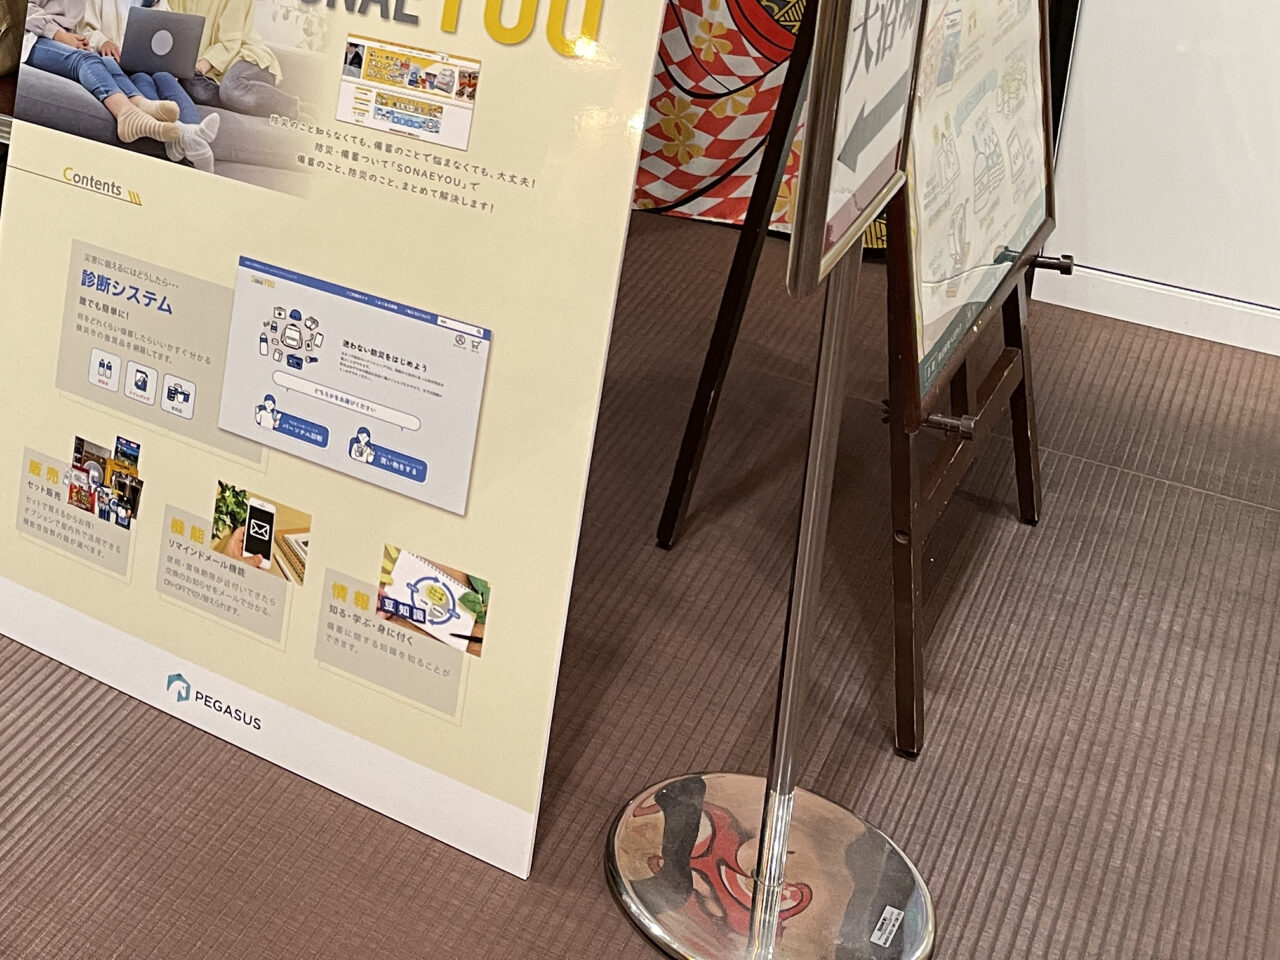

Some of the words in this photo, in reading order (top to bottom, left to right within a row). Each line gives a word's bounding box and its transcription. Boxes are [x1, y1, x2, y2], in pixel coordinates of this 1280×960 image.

[269, 114, 537, 190] 防災のこと知らなくても、備蓄のことで悩まなくても、大丈夫!
[63, 167, 122, 196] Contents
[296, 154, 495, 214] 備蓄のこと、防災のこと、まとめて解決します!
[79, 296, 130, 320] 誰でも簡単に!
[81, 269, 173, 315] 診断システム
[342, 339, 428, 372] 迷わない防災をはじめよう
[28, 459, 60, 485] 販売
[27, 480, 61, 502] セット販売
[168, 538, 246, 578] リマインドメール機能
[331, 581, 371, 612] 情報
[384, 598, 425, 623] 豆知識
[329, 604, 414, 646] 知る・学ぶ・身に付く
[325, 634, 359, 654] できます。
[194, 689, 262, 731] PEGASUS
